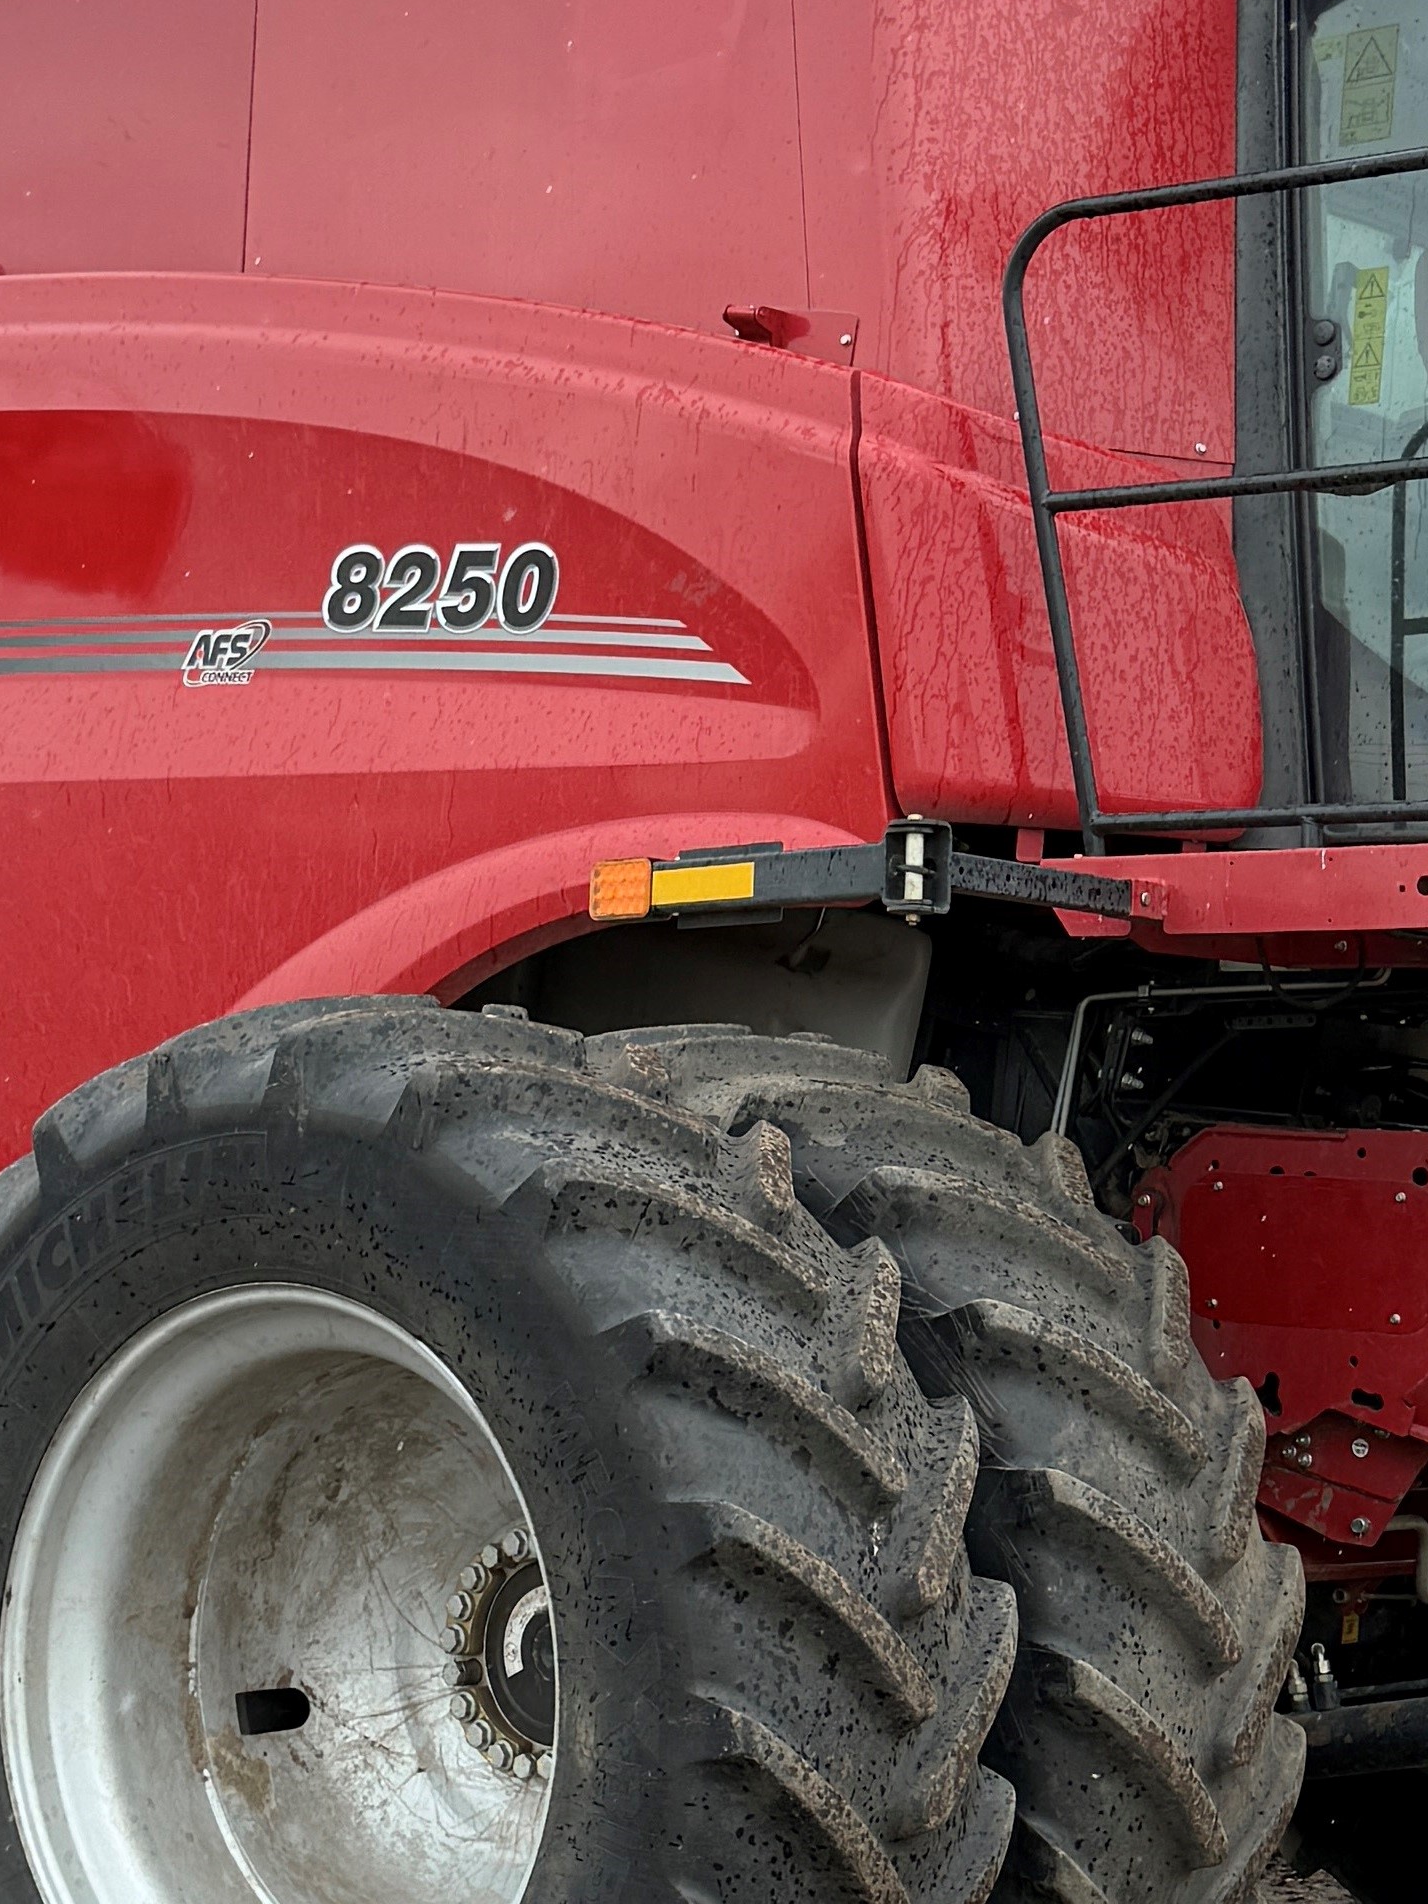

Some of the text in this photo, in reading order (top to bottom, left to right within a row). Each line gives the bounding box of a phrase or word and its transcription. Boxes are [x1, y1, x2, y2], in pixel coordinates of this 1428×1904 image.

[322, 542, 560, 634] 8250
[181, 629, 254, 671] AFS
[200, 670, 255, 685] CONNECT
